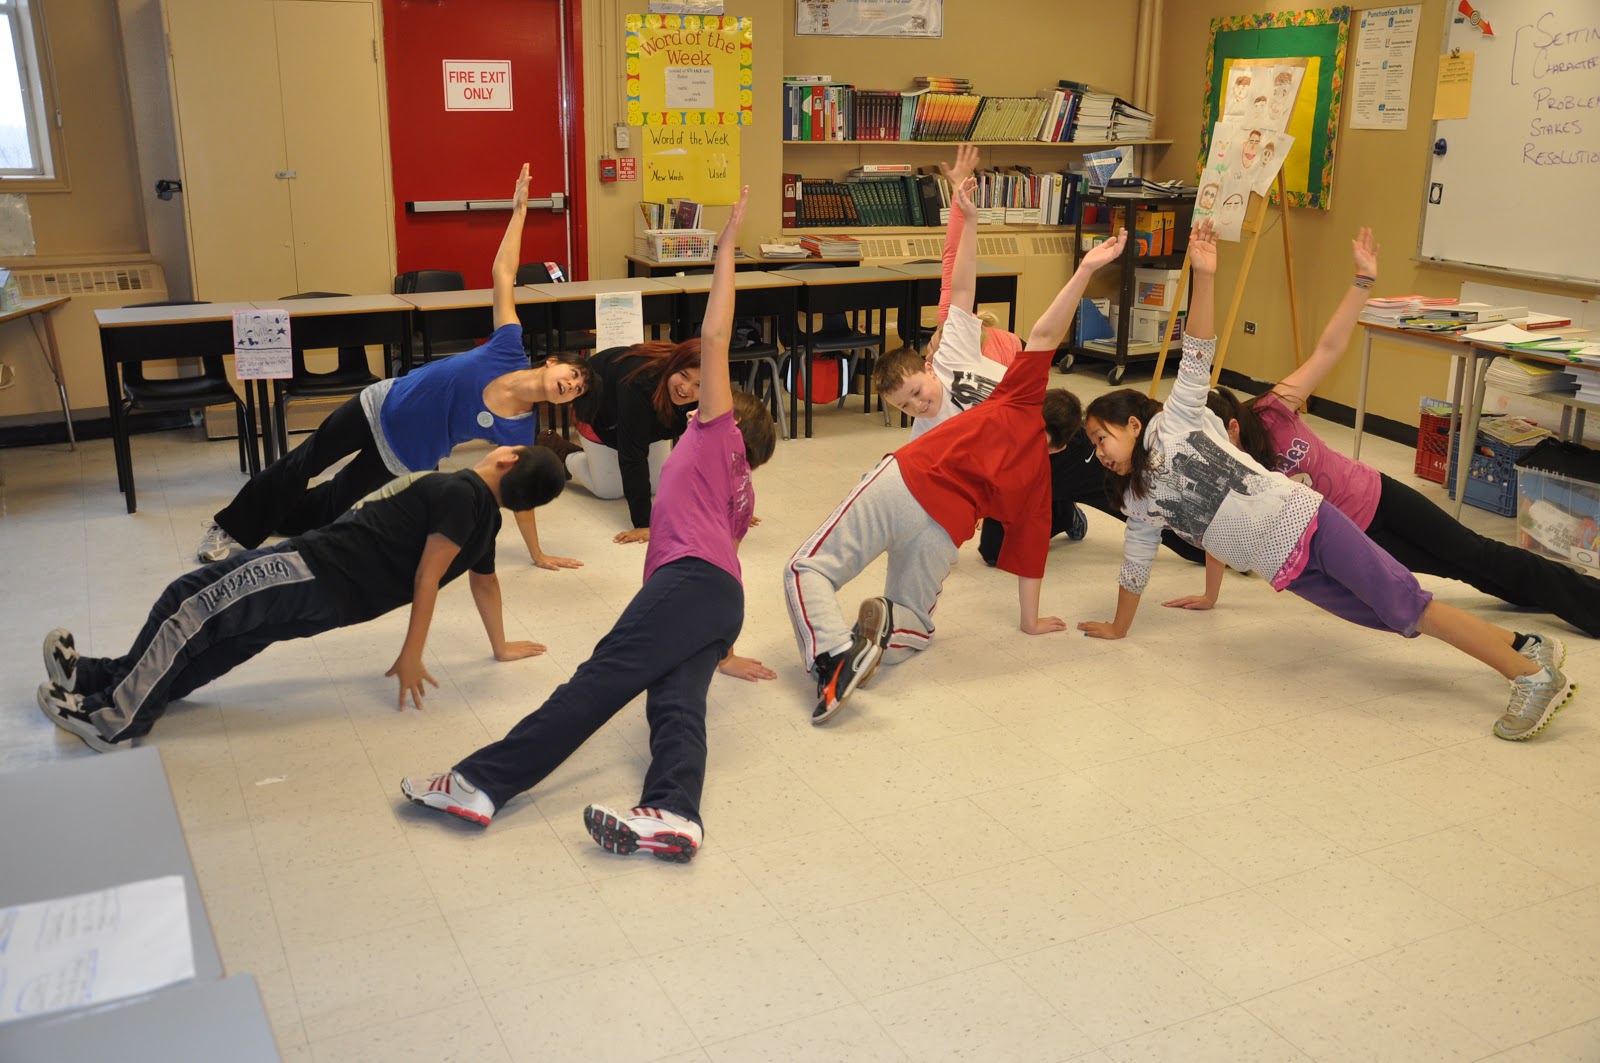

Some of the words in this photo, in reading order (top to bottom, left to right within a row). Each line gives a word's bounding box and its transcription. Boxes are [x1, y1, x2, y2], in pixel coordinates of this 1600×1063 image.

[1367, 8, 1398, 18] Punctuation
[1398, 6, 1414, 15] Rules
[640, 30, 683, 56] Word
[685, 29, 704, 46] of
[707, 31, 736, 54] the
[666, 49, 712, 65] Week
[449, 71, 475, 83] FIRE
[480, 71, 506, 83] EXIT
[463, 87, 493, 100] ONLY
[1530, 117, 1582, 137] STAKES
[649, 128, 675, 145] Word
[676, 131, 684, 145] of
[689, 131, 703, 145] the
[704, 130, 729, 146] Week
[651, 169, 667, 182] New
[668, 169, 684, 181] Words
[708, 166, 727, 179] Used
[198, 558, 291, 613] basketball
